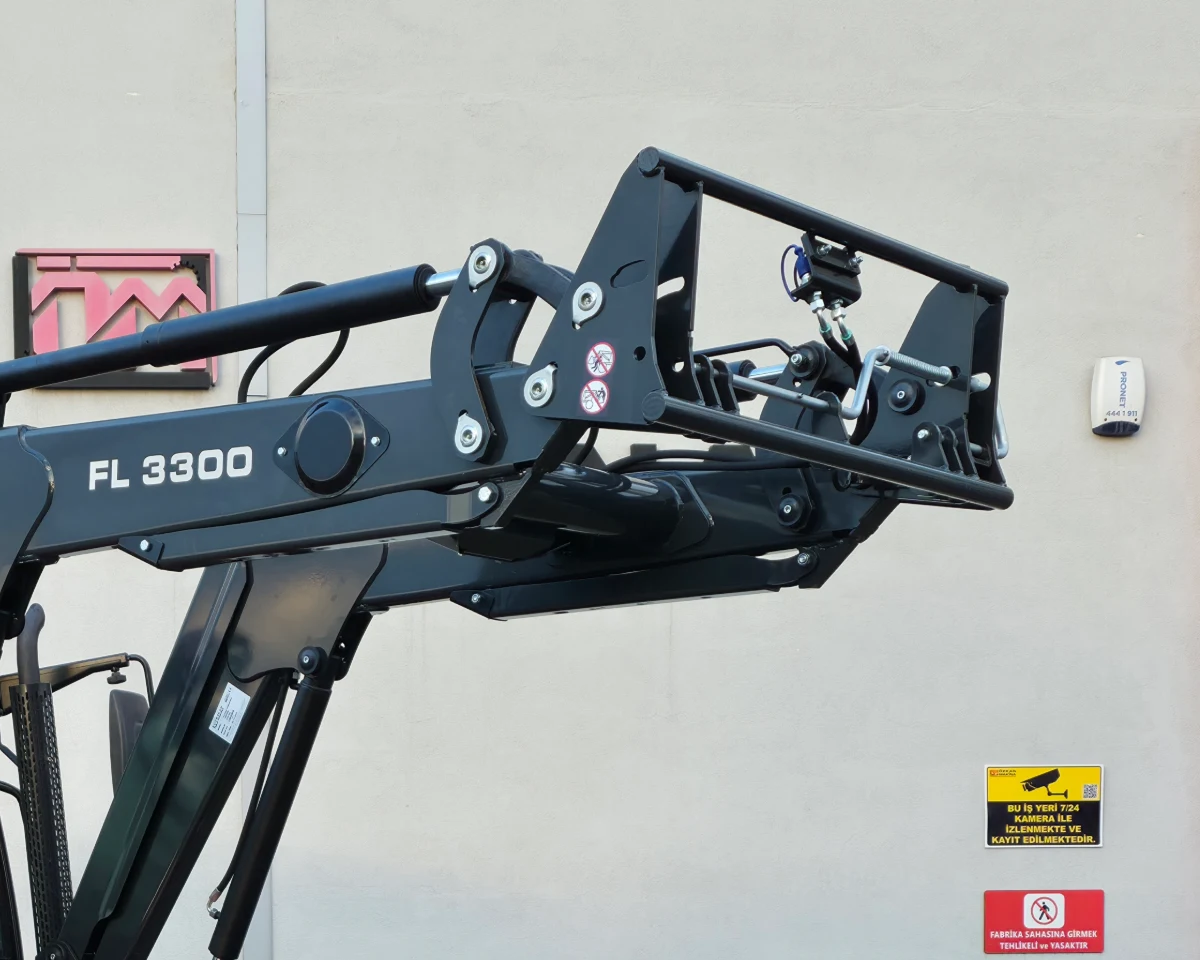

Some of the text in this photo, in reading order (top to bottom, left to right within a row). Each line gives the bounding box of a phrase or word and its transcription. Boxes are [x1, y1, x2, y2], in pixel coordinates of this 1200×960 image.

[1119, 371, 1127, 408] PRONET
[89, 445, 253, 490] FL 3300
[1007, 803, 1080, 813] BU İŞ YERİ 7/24
[1014, 813, 1073, 823] KAMERA İLE
[1005, 824, 1082, 833] İZLENMEKTE VE
[991, 833, 1096, 844] KAYIT EDİLMEKTEDİR.
[990, 929, 1098, 939] FABRİKA SAHASINA GİRMEK
[999, 941, 1038, 950] TEHLİKELİ
[1050, 941, 1088, 950] YASAKTIR
